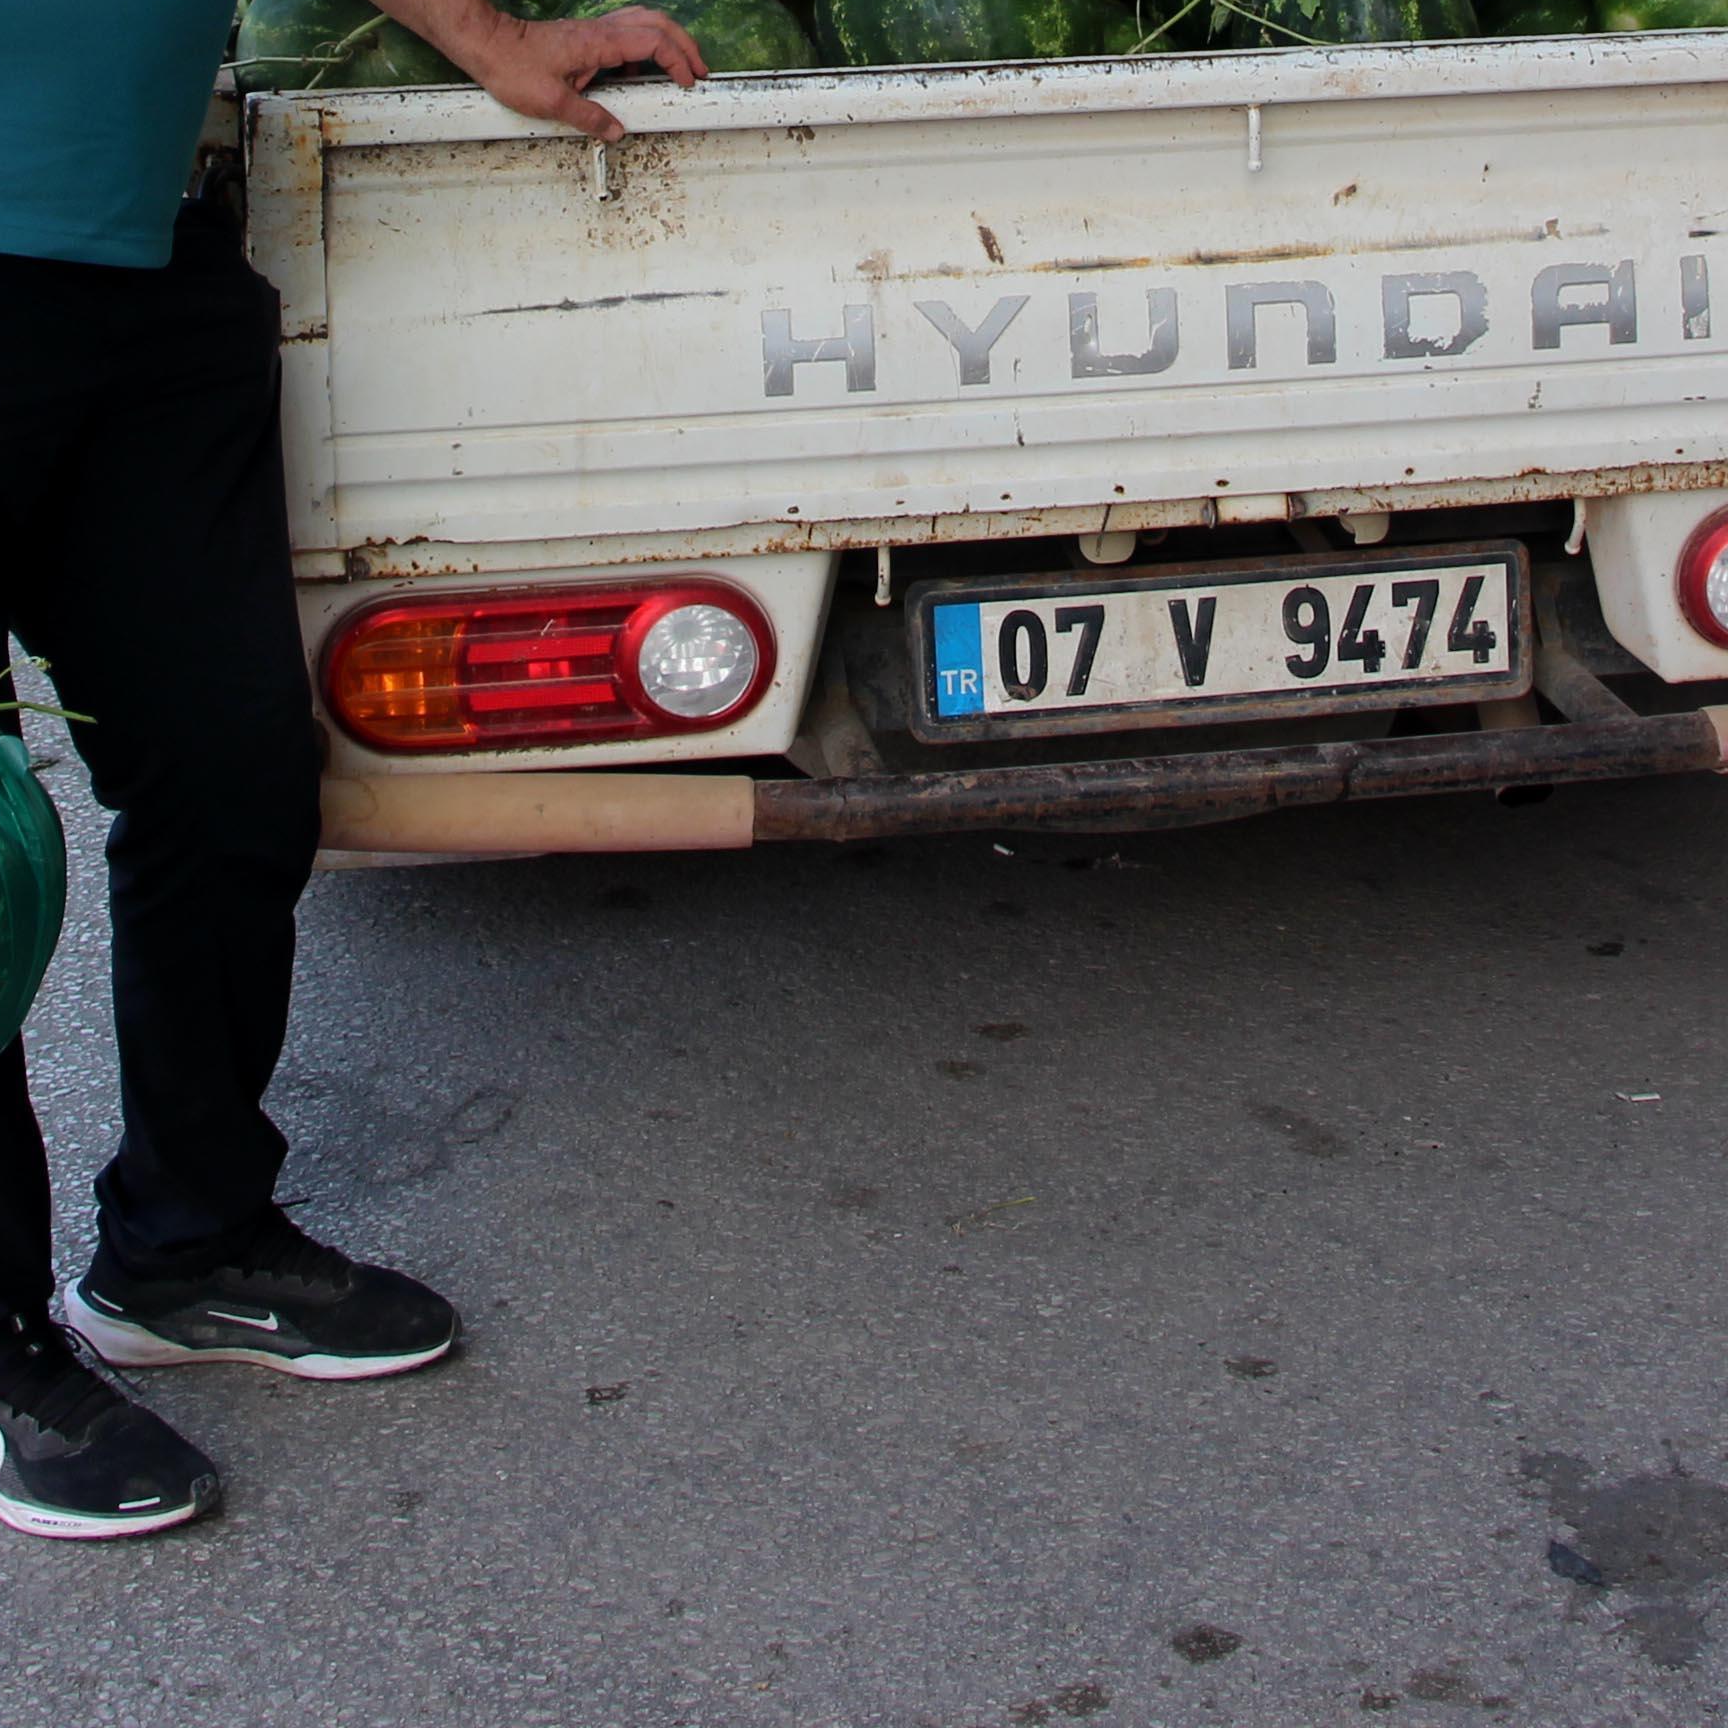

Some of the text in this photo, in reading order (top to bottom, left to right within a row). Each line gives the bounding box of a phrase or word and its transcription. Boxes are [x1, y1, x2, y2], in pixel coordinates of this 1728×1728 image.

[761, 253, 1712, 398] HYUNDAI
[940, 574, 1498, 702] TR 07 V 9474
